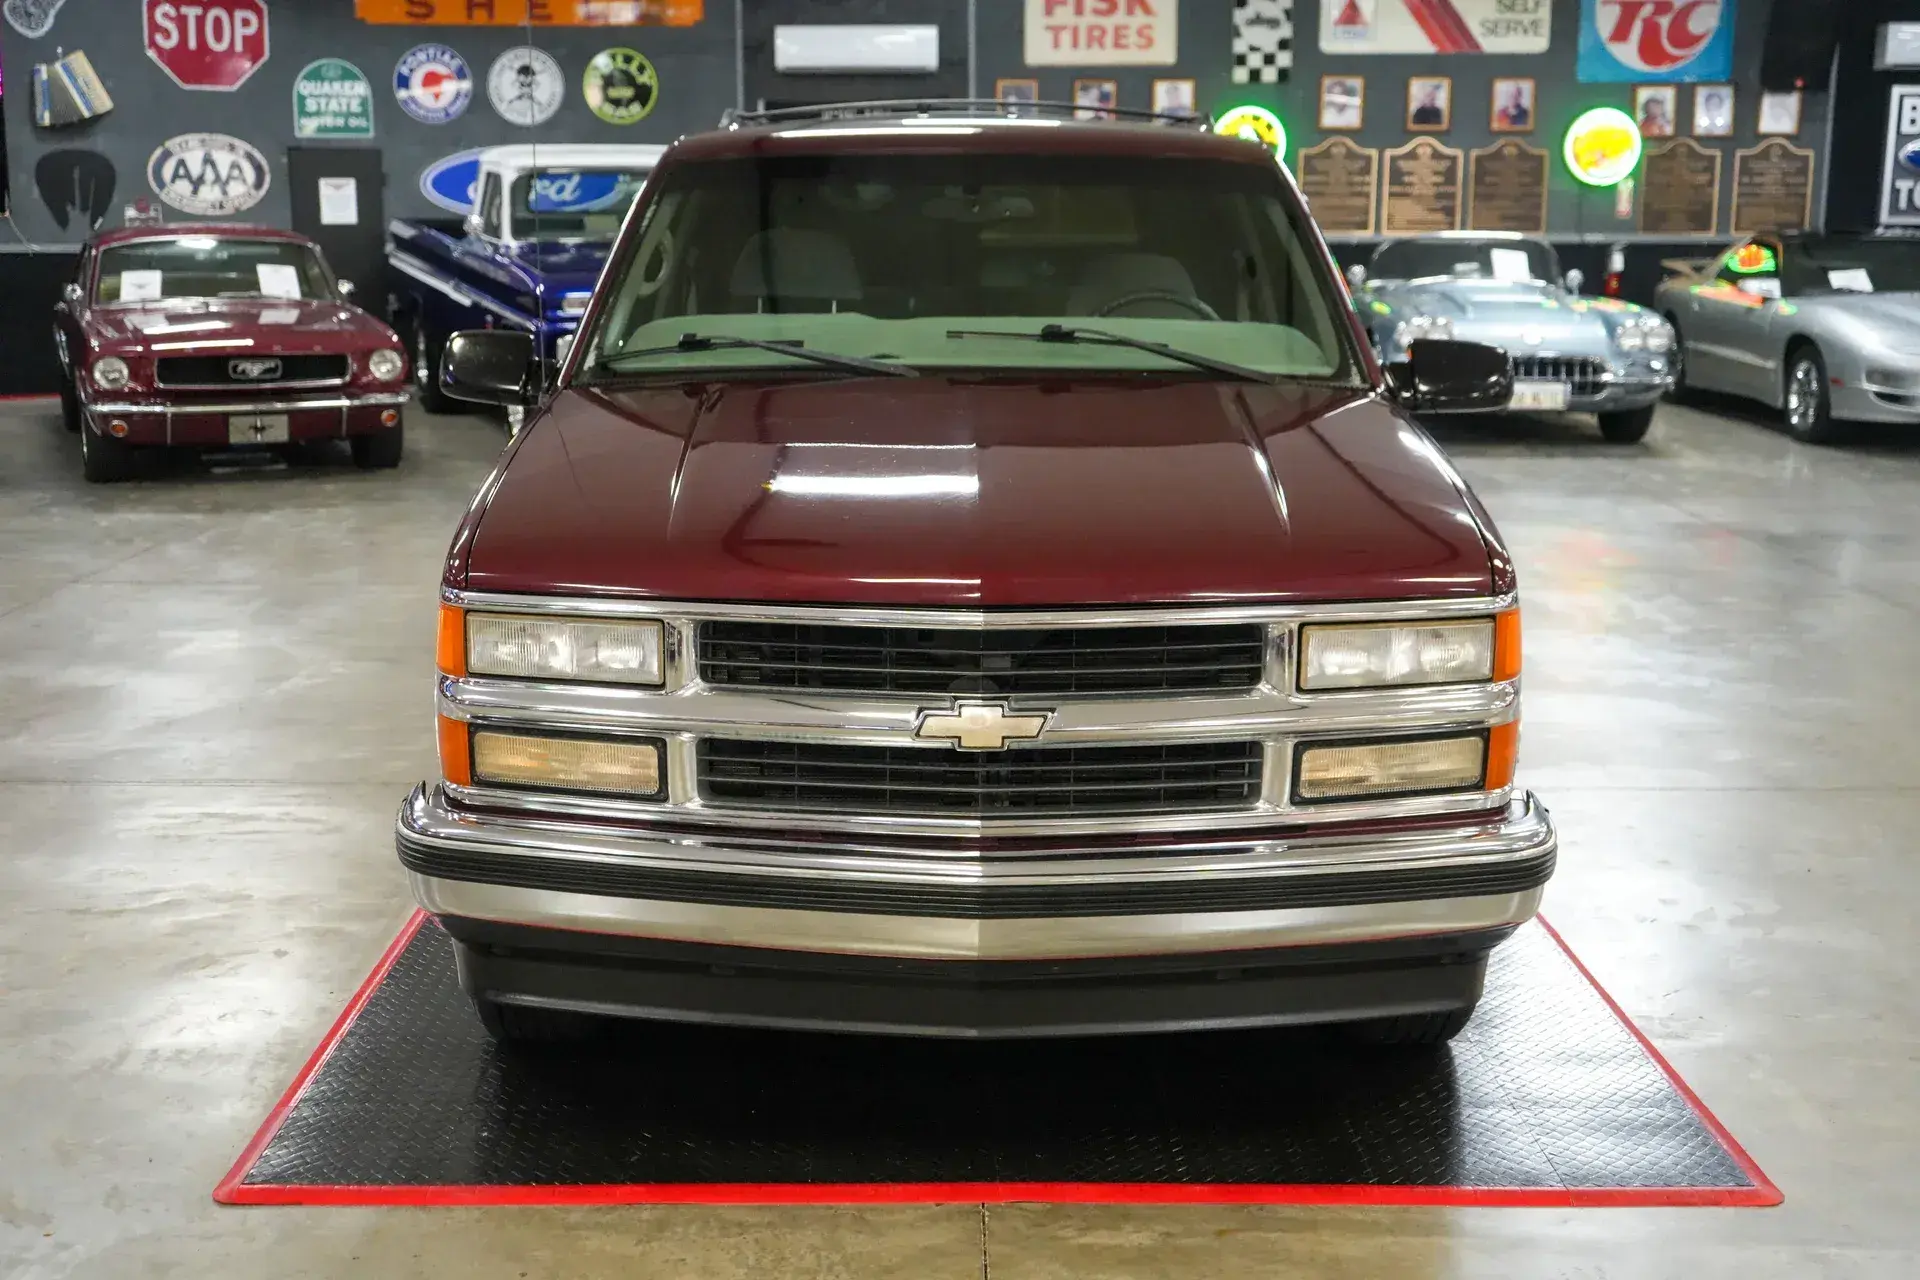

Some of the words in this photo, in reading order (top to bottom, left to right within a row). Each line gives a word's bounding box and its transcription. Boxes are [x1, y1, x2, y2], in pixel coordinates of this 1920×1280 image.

[154, 3, 259, 53] STOP
[1044, 24, 1156, 51] TIRES
[1479, 18, 1545, 38] SERVE
[1601, 0, 1718, 66] RC
[299, 80, 367, 97] QUAKER
[304, 96, 363, 114] STATE
[170, 151, 248, 196] AAA
